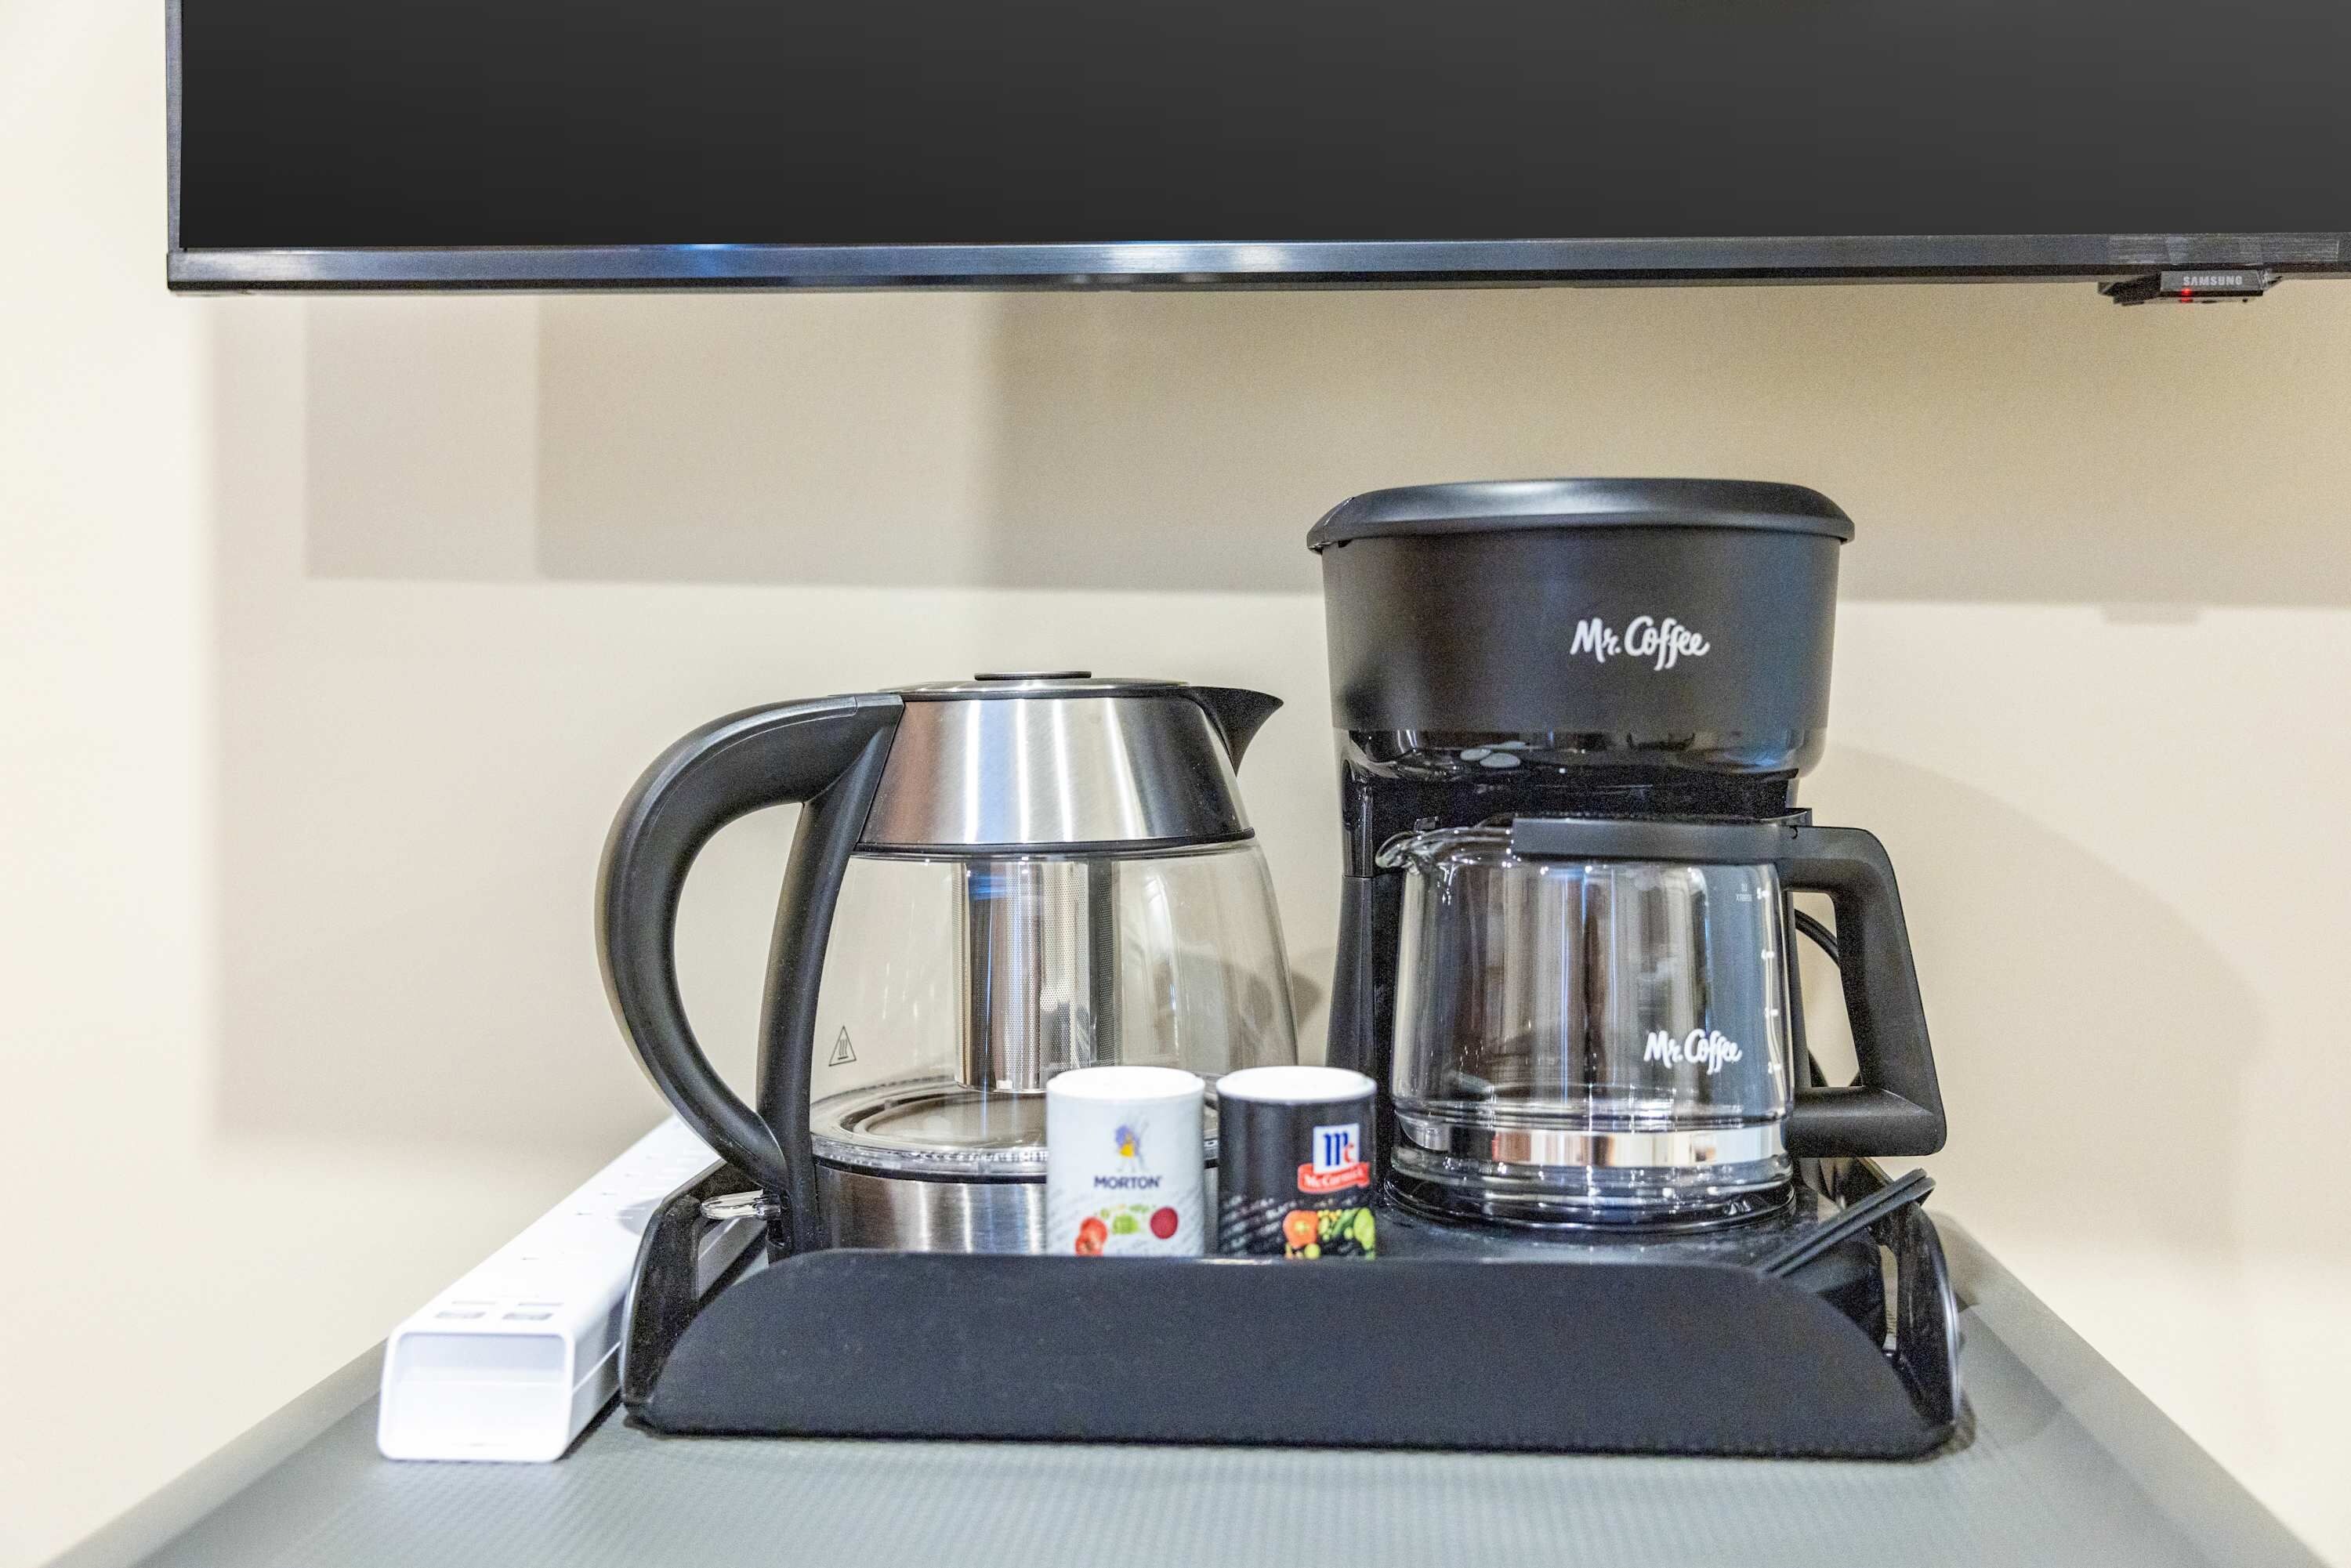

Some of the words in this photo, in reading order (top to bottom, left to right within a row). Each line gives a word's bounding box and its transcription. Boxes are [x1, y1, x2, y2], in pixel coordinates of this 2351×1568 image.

[2183, 275, 2243, 286] SAMSUNG
[1570, 617, 1621, 663] Mr.
[1624, 615, 1711, 672] Coffee
[1643, 1030, 1684, 1069] Mr.
[1684, 1028, 1743, 1076] Coffee
[1094, 1175, 1159, 1190] MORTON
